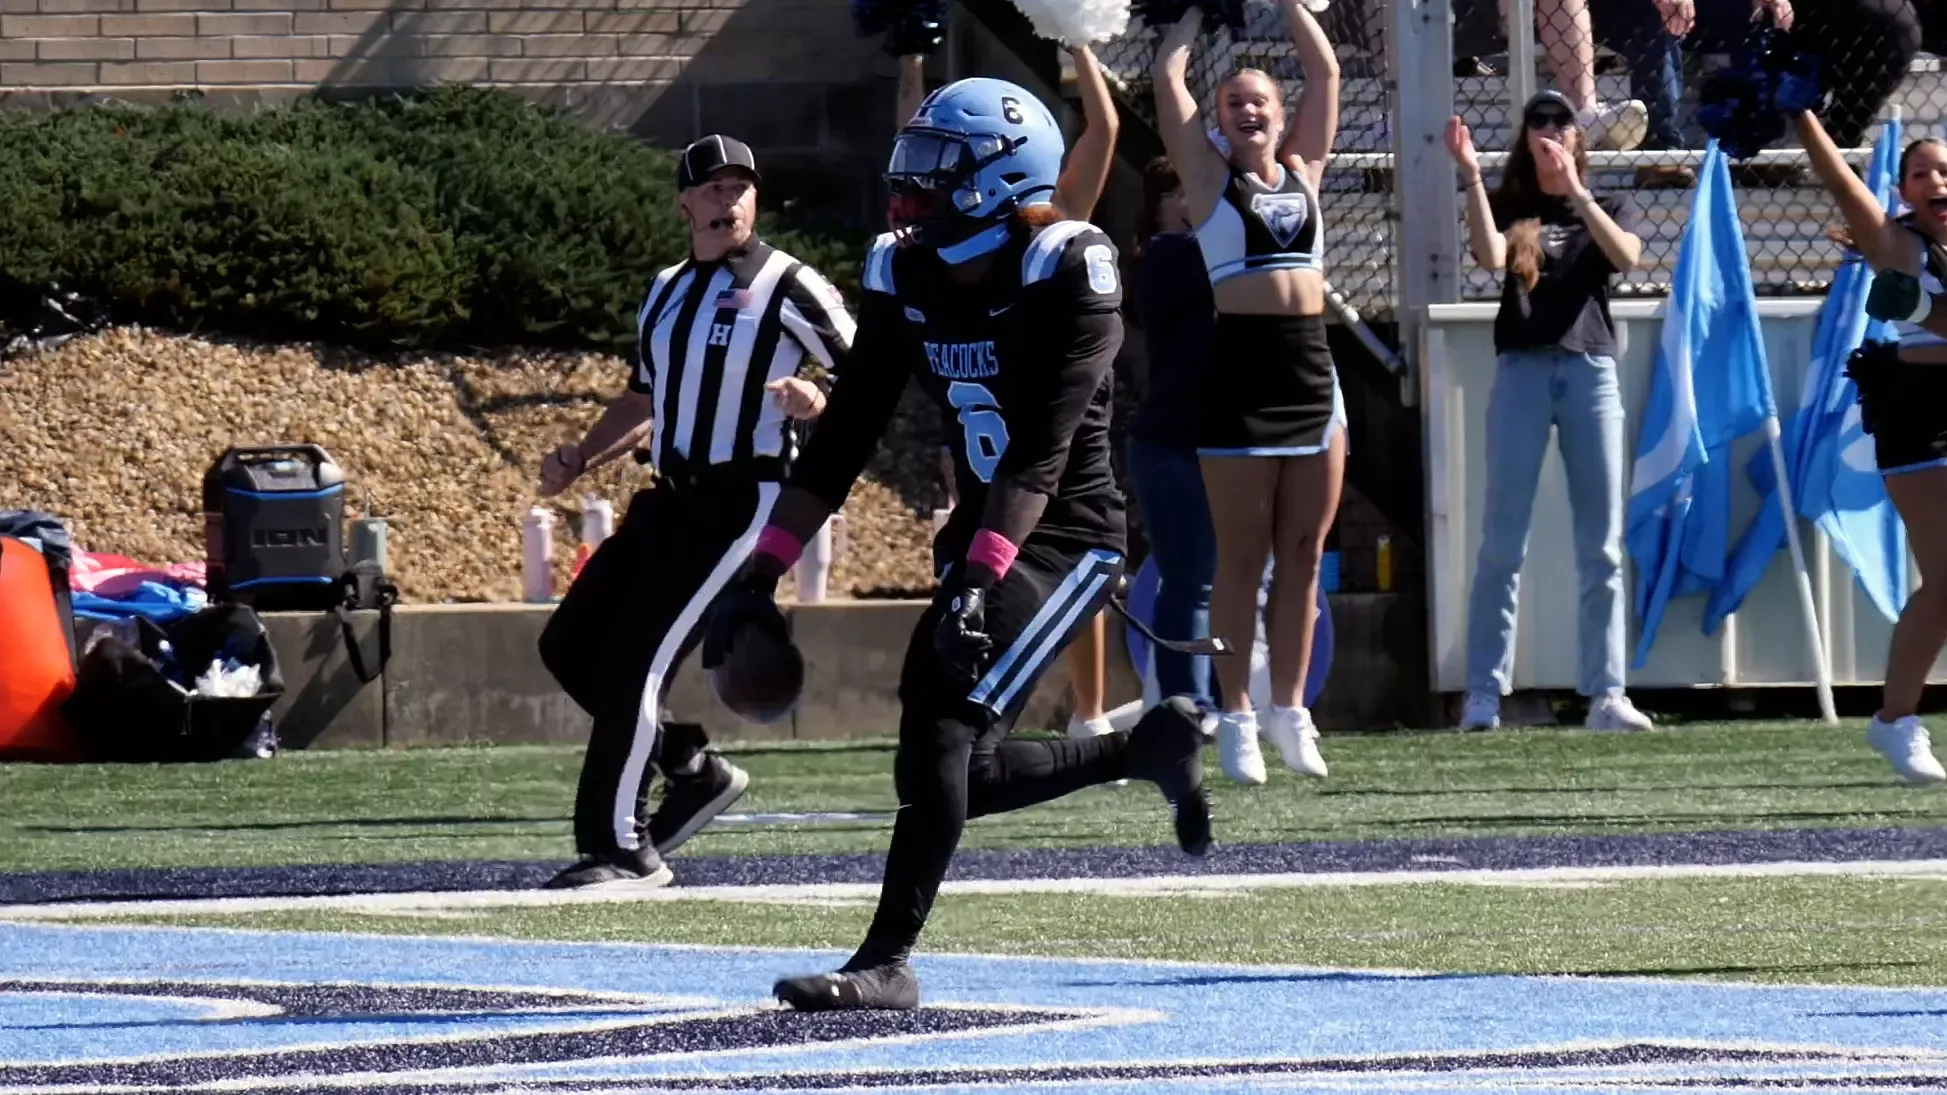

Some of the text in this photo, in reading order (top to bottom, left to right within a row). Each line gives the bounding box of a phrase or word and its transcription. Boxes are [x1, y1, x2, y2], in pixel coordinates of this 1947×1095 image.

[1002, 96, 1024, 124] 6
[1083, 244, 1117, 294] 6
[708, 323, 732, 346] H
[947, 380, 1010, 483] 6
[252, 528, 328, 547] ION
